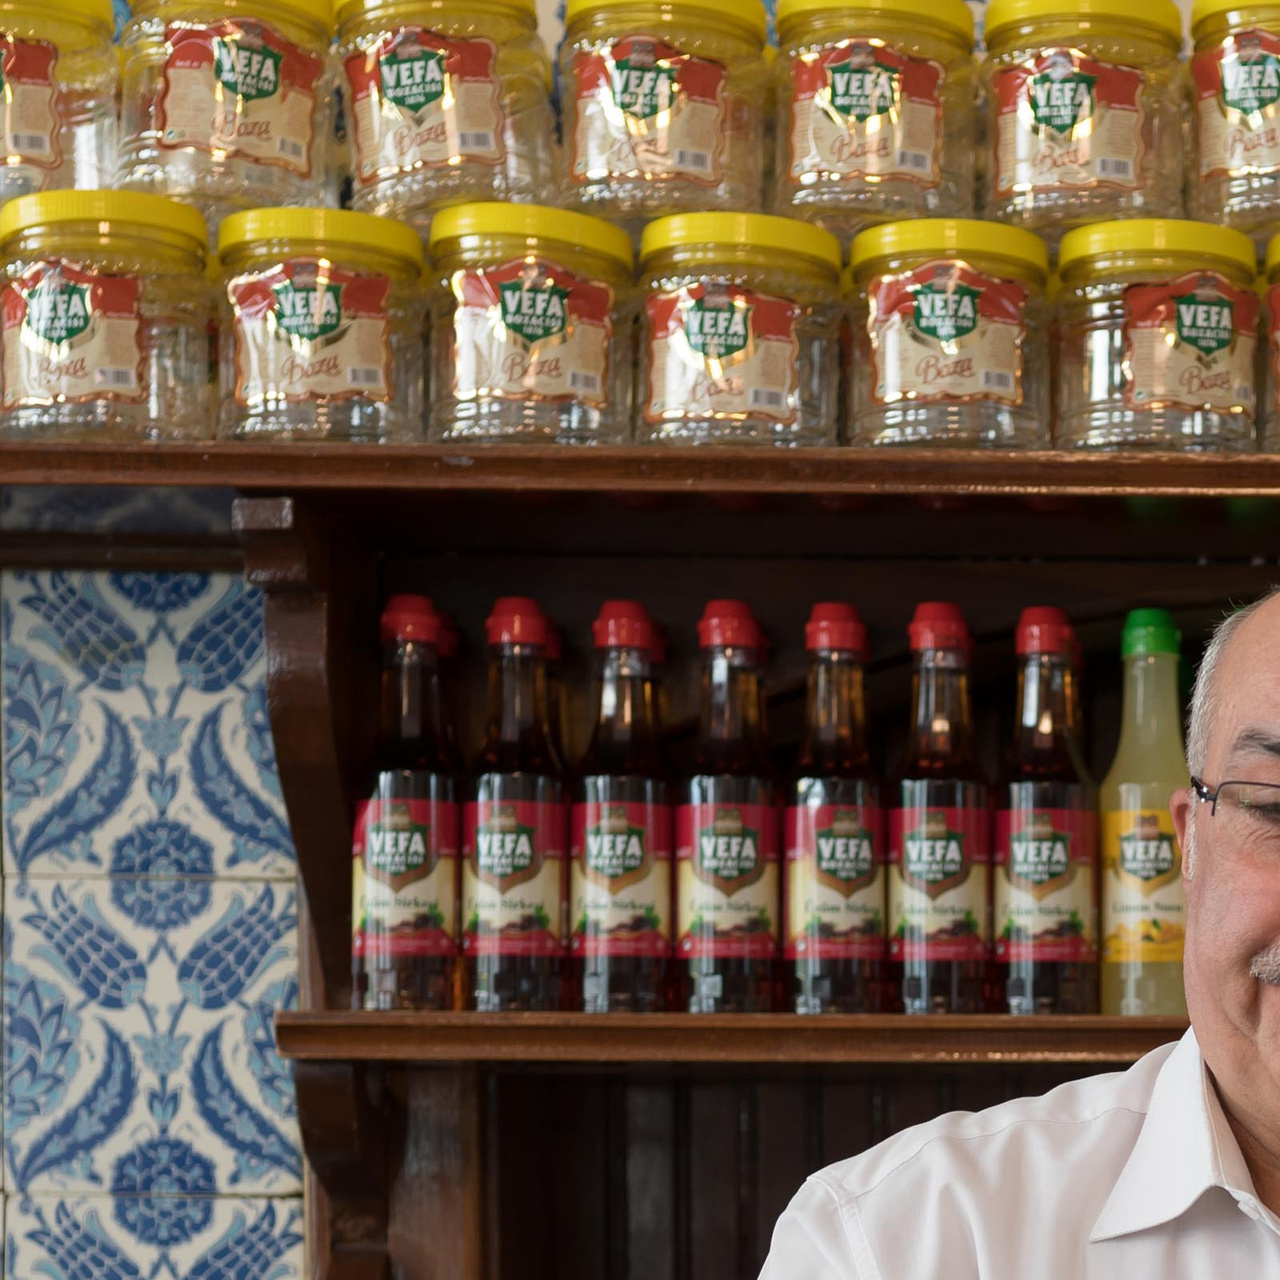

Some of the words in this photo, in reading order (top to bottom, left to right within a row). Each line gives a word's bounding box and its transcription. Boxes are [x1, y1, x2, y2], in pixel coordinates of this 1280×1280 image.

[220, 48, 276, 77] VEFA
[381, 59, 442, 86] VEFA
[619, 69, 671, 94] VEFA
[834, 73, 893, 97] VEFA
[1223, 65, 1280, 87] VEFA
[1035, 83, 1090, 105] VEFA
[394, 122, 448, 149] Boza
[279, 292, 339, 315] VEFA
[504, 290, 563, 316] VEFA
[917, 294, 975, 317] VEFA
[687, 311, 745, 335] VEFA
[1178, 304, 1232, 328] VEFA
[281, 356, 341, 384] Boza
[915, 355, 975, 384] Boza
[1177, 365, 1232, 394] Boza
[371, 832, 426, 854] VEFA
[477, 833, 532, 855] VEFA
[587, 834, 642, 857] VEFA
[701, 835, 756, 858] VEFA
[818, 838, 872, 860] VEFA
[906, 840, 962, 862] VEFA
[1012, 840, 1067, 863] VEFA
[1121, 840, 1173, 861] VEFA
